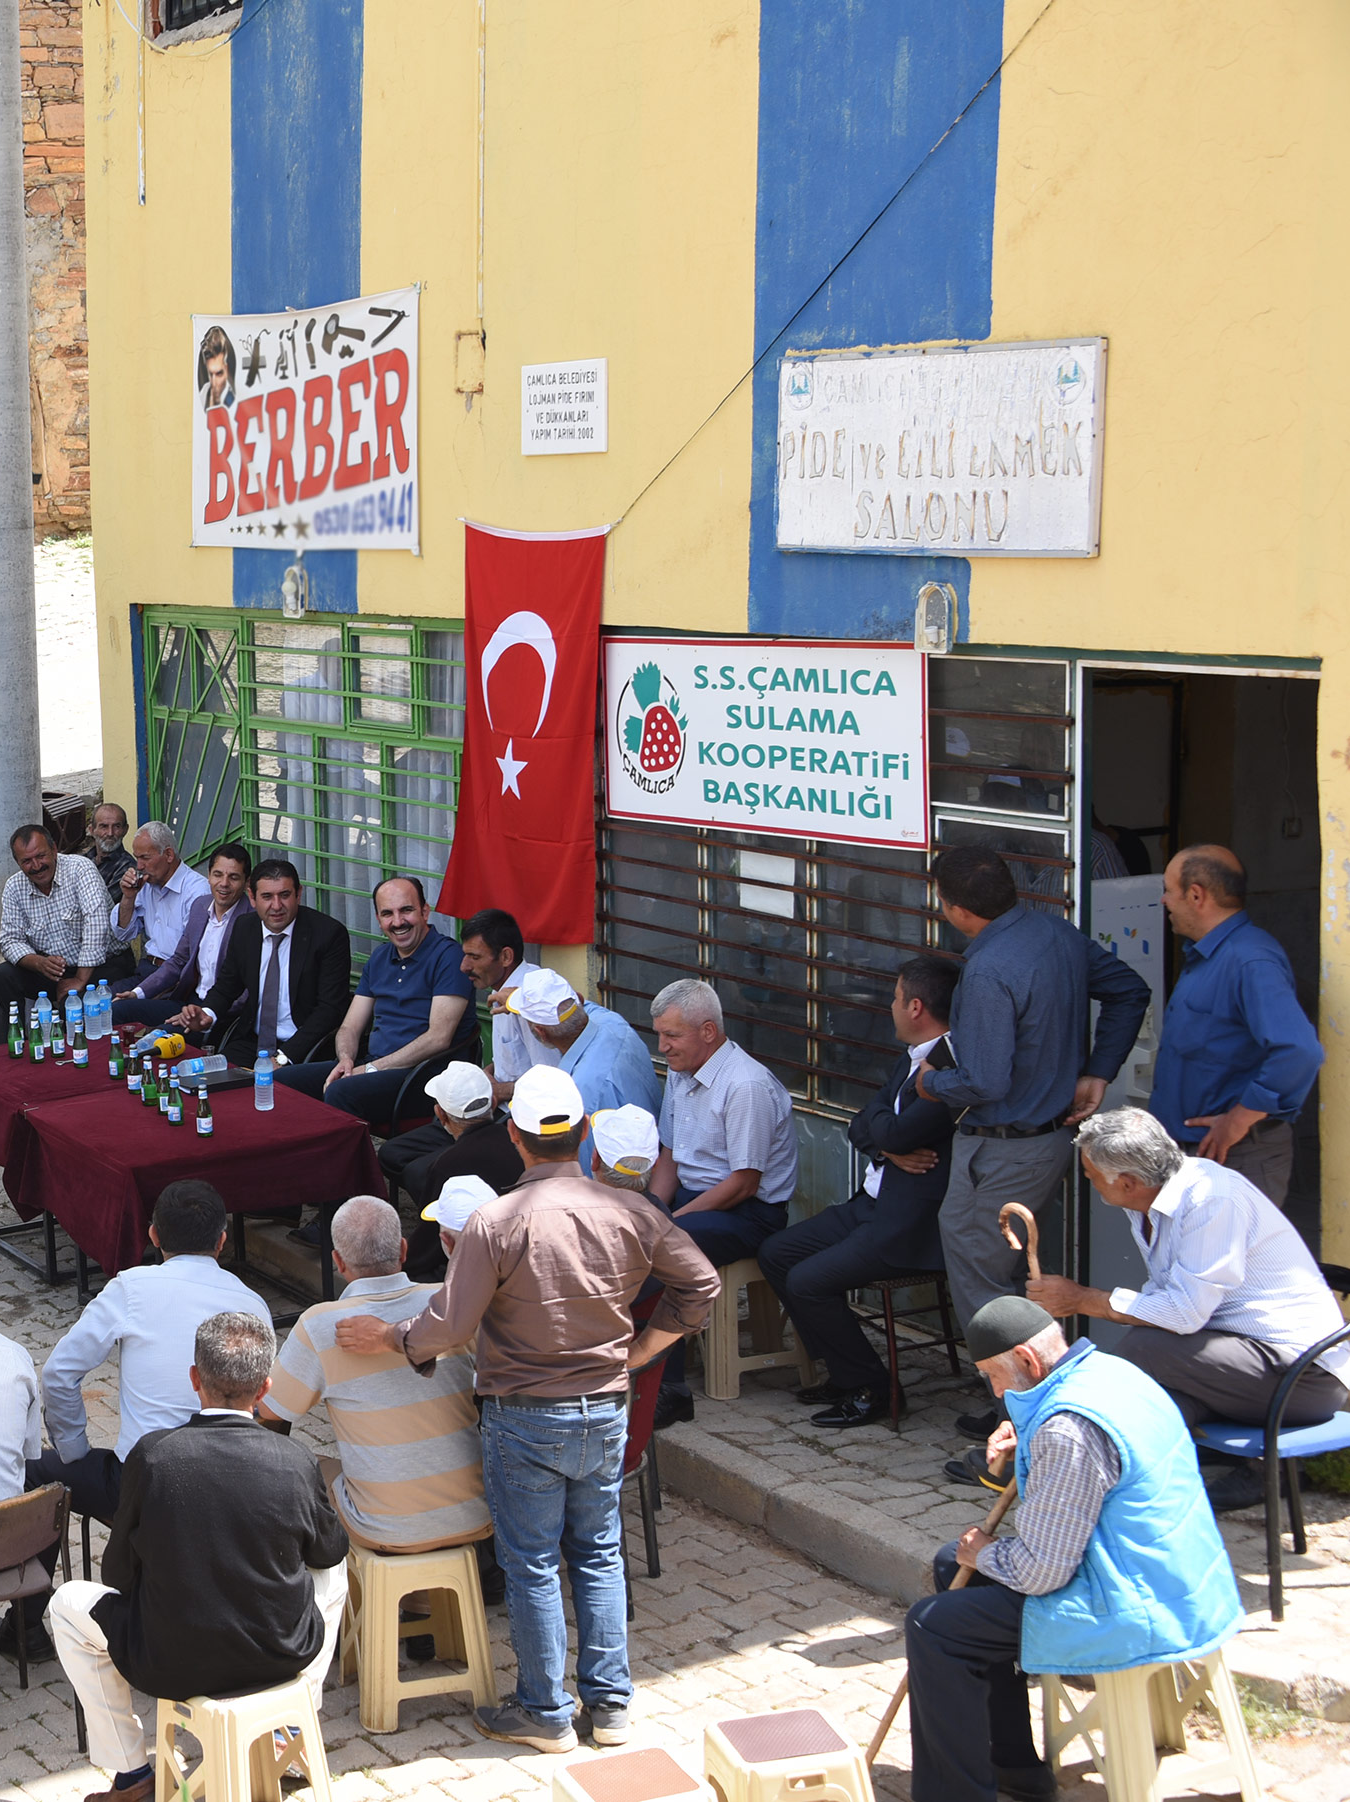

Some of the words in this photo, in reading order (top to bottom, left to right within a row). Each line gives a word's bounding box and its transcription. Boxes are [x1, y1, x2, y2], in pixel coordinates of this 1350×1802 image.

[529, 391, 556, 406] LOJMAN
[558, 389, 573, 404] PİDE
[575, 391, 595, 403] FIRINI
[531, 429, 552, 440] YAPIM
[578, 427, 594, 439] 2002
[536, 412, 544, 424] VE
[546, 409, 589, 423] DÜKKANLARI
[204, 347, 410, 524] BERBER
[782, 421, 847, 480] PİDE
[854, 489, 1009, 543] SALONU
[726, 704, 860, 735] SULAMA
[703, 779, 893, 820] BAŞKANLIĞI
